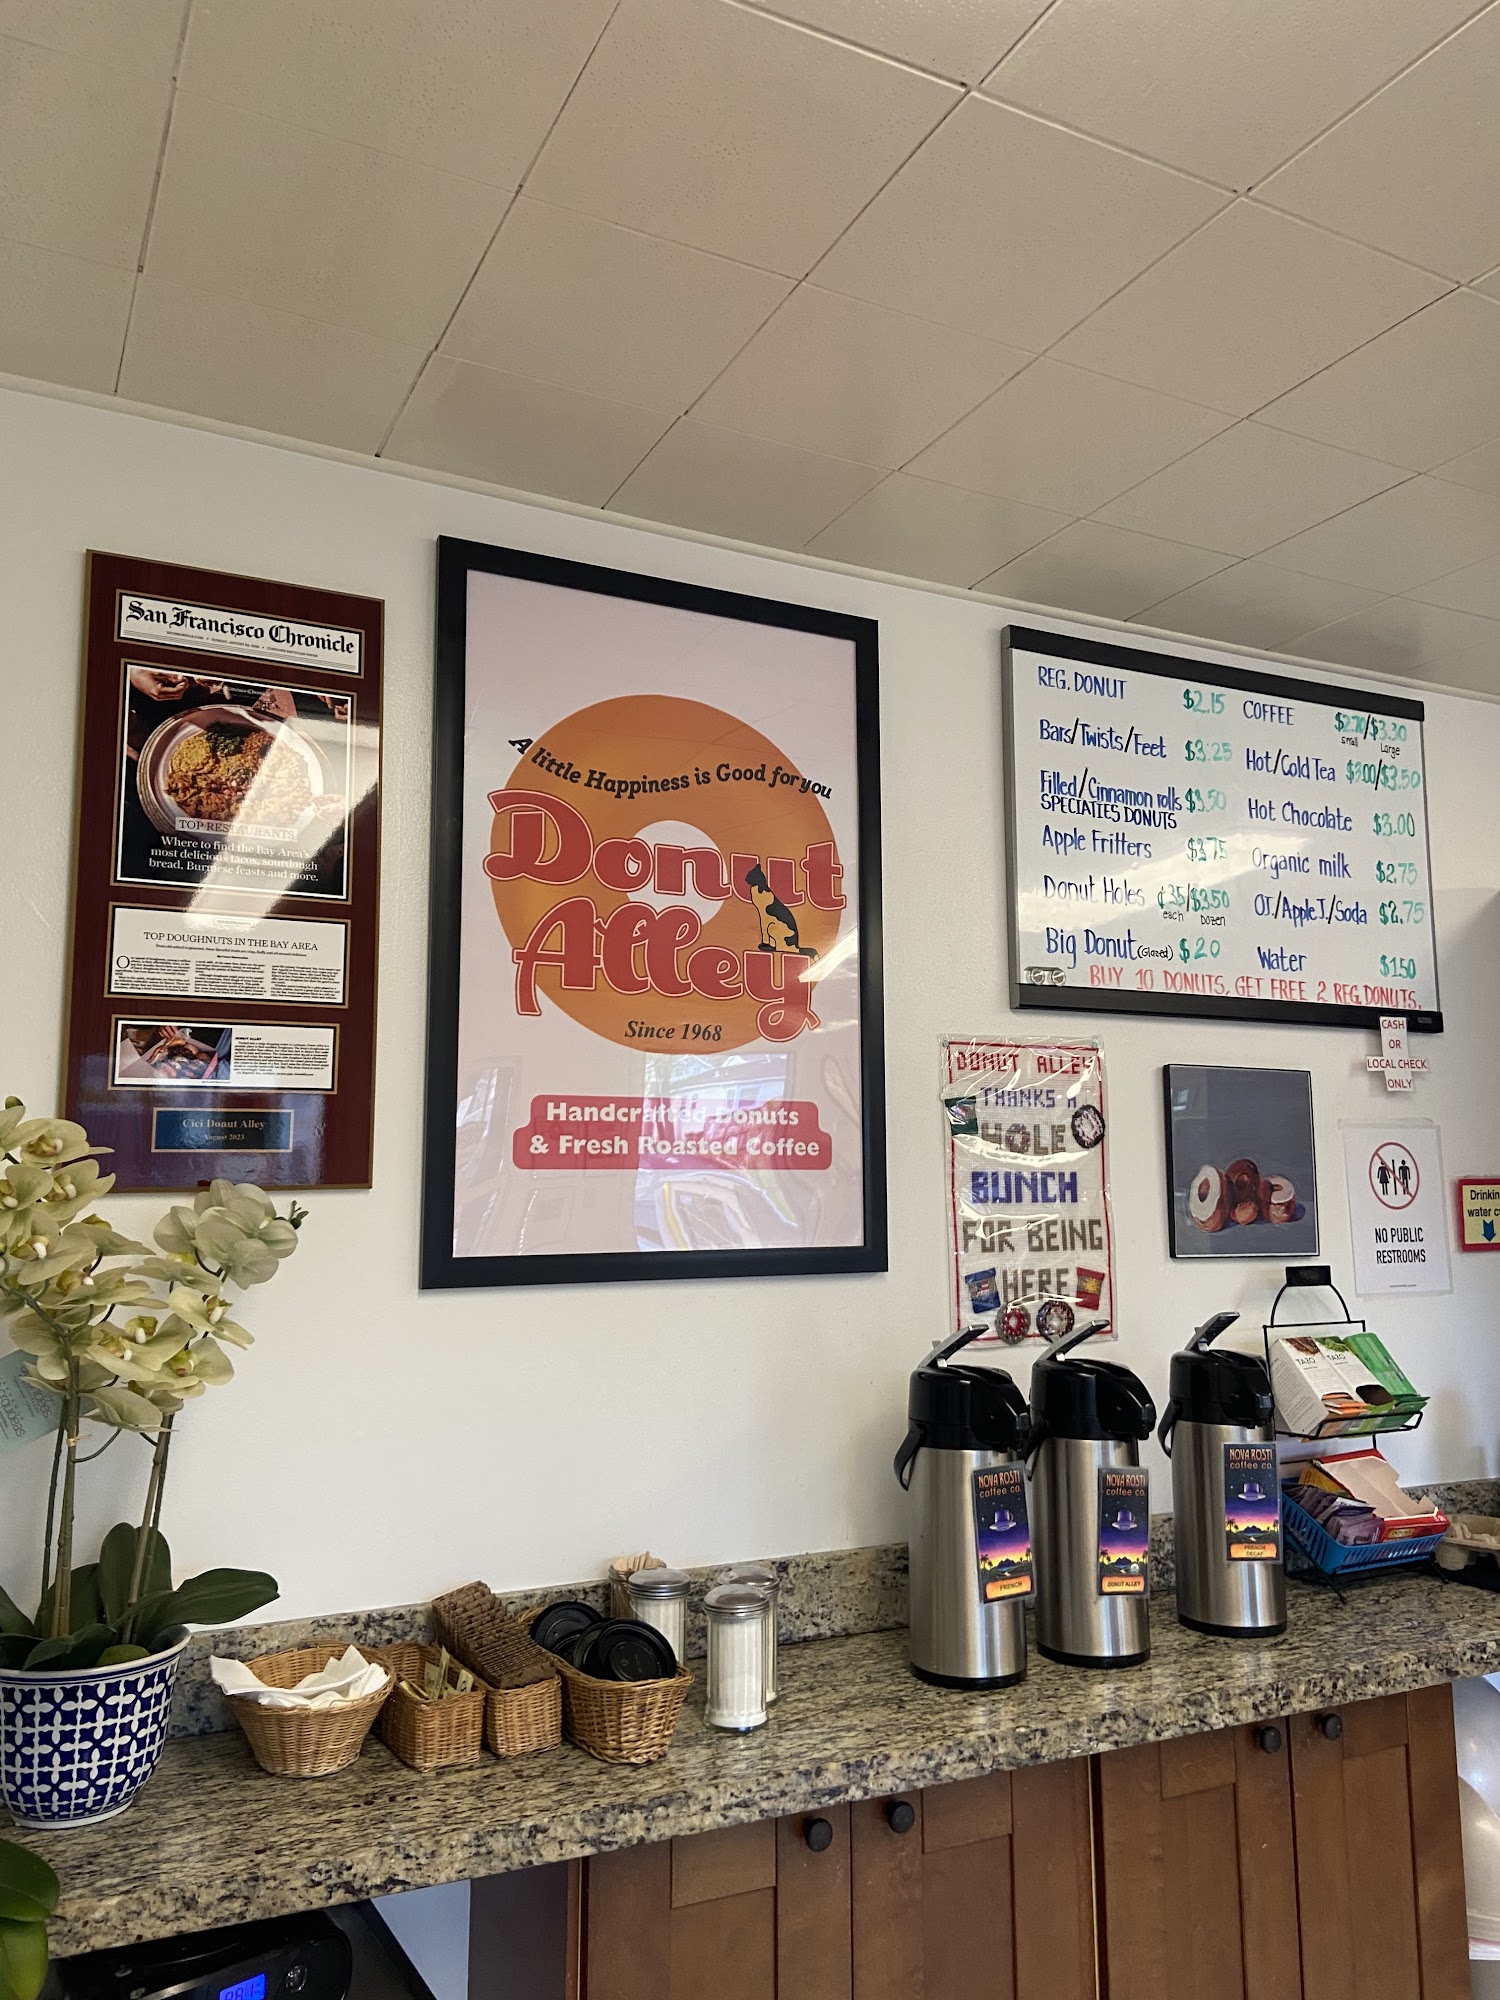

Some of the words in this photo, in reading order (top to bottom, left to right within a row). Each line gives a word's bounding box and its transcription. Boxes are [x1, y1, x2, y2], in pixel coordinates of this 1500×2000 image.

[126, 601, 168, 624] San
[169, 607, 264, 639] Francisco
[269, 625, 354, 653] Chronicle
[1037, 666, 1071, 691] REG.
[1074, 671, 1127, 699] DONUT
[1243, 700, 1294, 725] COFFEE
[1039, 717, 1167, 758] Bars/Twists/Feet
[508, 738, 533, 755] A
[531, 747, 582, 783] little
[584, 769, 690, 799] Happiness
[694, 767, 711, 786] is
[716, 763, 766, 782] Good
[768, 766, 799, 788] for
[798, 776, 833, 799] you
[1246, 748, 1310, 779] Hot/Cold
[1312, 757, 1336, 781] Tea
[1040, 767, 1153, 808] Filled/Cinnamon
[1157, 786, 1182, 811] rolls
[1124, 806, 1177, 830] DONUTS
[1248, 797, 1276, 821] Hot
[1282, 801, 1353, 831] Chocolate
[1373, 812, 1415, 837] $3.00
[178, 819, 204, 830] TOP
[206, 820, 296, 841] RESTAURANTS
[1042, 825, 1086, 856] Apple
[1092, 829, 1152, 858] Fritters
[161, 835, 199, 848] Where
[200, 838, 211, 849] to
[213, 839, 235, 852] find
[237, 843, 255, 853] the
[257, 845, 275, 857] Bay
[278, 847, 310, 859] Area's
[483, 788, 847, 911] Donut
[149, 857, 184, 870] bread,
[186, 860, 234, 874] Burmese
[236, 866, 266, 878] feasts
[267, 868, 288, 879] and
[289, 871, 319, 882] more.
[150, 847, 178, 858] most
[180, 849, 228, 863] delicious
[230, 854, 261, 866] tacos,
[263, 856, 318, 872] sourdough
[1252, 847, 1310, 879] Organic
[1319, 852, 1352, 878] milk
[1375, 860, 1418, 885] $2.75
[1043, 874, 1098, 903] Donut
[1103, 876, 1145, 906] Holes
[1162, 911, 1184, 921] each
[1379, 900, 1425, 925] $2.75
[144, 931, 165, 941] TOP
[166, 933, 233, 946] DOUGHNUTS
[234, 936, 246, 946] IN
[247, 937, 269, 948] THE
[270, 939, 290, 949] BAY
[291, 941, 318, 951] AREA
[1046, 926, 1077, 969] Big
[1083, 929, 1138, 960] Donut
[512, 896, 820, 1042] Alley
[1257, 946, 1307, 971] Water
[1090, 964, 1123, 988] BUY
[1135, 968, 1154, 990] 10
[1163, 969, 1230, 996] DONUTS,
[1235, 975, 1264, 998] GET
[1270, 978, 1308, 1001] FREE
[1316, 980, 1328, 1003] 2
[624, 1020, 675, 1040] Since
[681, 1022, 724, 1042] 1968
[1382, 1020, 1405, 1029] CASH
[1389, 1039, 1401, 1049] OR
[956, 1051, 1020, 1072] DONUT
[1367, 1059, 1396, 1069] LOCAL
[1398, 1059, 1427, 1069] CHECK
[1388, 1079, 1412, 1089] ONLY
[981, 1086, 1056, 1109] THANKS
[182, 1118, 203, 1129] Cici
[206, 1119, 238, 1129] Donut
[240, 1119, 266, 1131] Alley
[547, 1101, 707, 1123] Handcrafted
[715, 1106, 799, 1125] Donuts
[529, 1134, 550, 1155] &
[559, 1134, 628, 1155] Fresh
[638, 1135, 738, 1156] Roasted
[746, 1137, 820, 1157] Coffee
[971, 1170, 1078, 1204] BUNCH
[1470, 1189, 1500, 1201] Drinkin
[1467, 1206, 1492, 1217] water
[962, 1218, 1015, 1253] FOR
[1027, 1218, 1103, 1252] BEING
[1375, 1227, 1388, 1243] NO
[1391, 1227, 1424, 1243] PUBLIC
[1376, 1248, 1426, 1264] RESTROOMS
[1002, 1267, 1070, 1303] HERE
[1229, 1448, 1250, 1461] NOVA
[1251, 1448, 1273, 1461] ROSTI
[1230, 1460, 1258, 1469] coffee
[978, 1473, 998, 1489] NOVA
[1000, 1469, 1021, 1486] ROSTI
[1106, 1473, 1125, 1487] NOVA
[1126, 1473, 1146, 1487] ROSTI
[980, 1487, 1008, 1499] coffee
[1106, 1487, 1132, 1497] coffee
[1000, 1580, 1023, 1592] FRENCH
